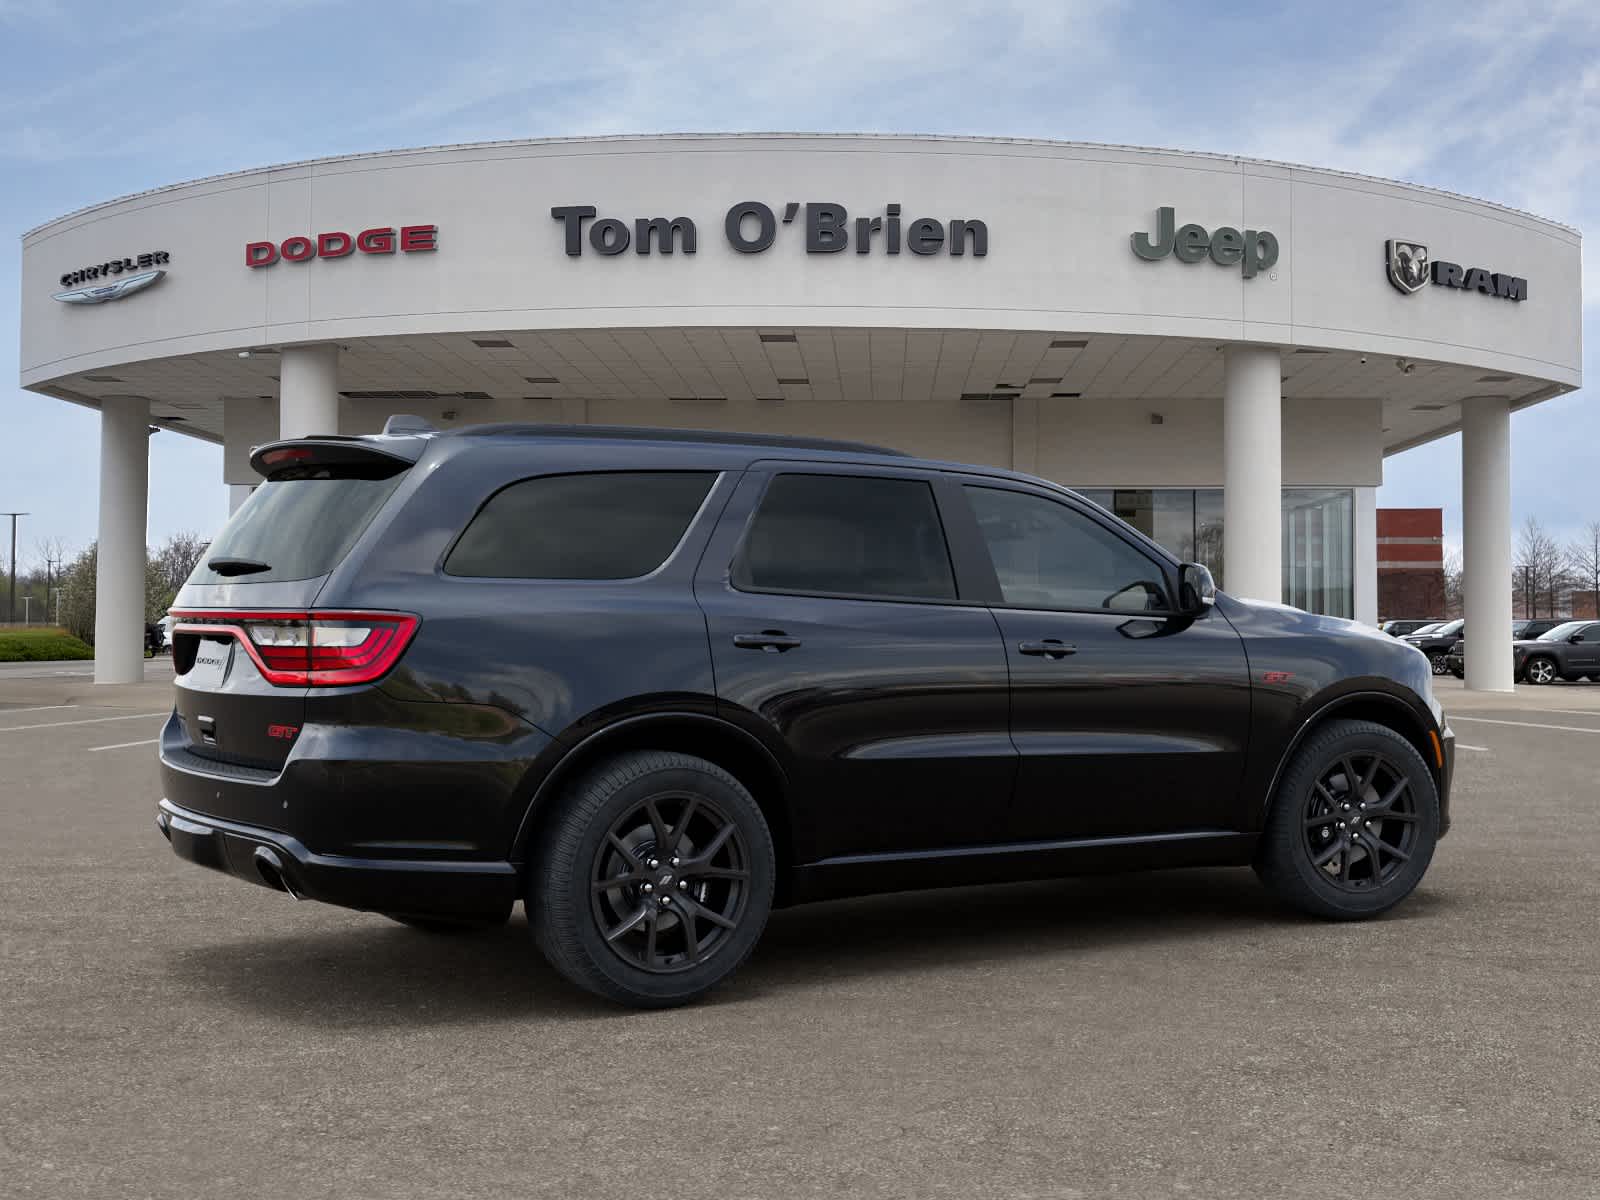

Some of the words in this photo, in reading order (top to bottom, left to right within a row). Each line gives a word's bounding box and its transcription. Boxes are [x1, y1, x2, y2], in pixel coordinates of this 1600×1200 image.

[245, 225, 437, 269] DODGE
[551, 205, 697, 256] Tom
[725, 200, 989, 256] O'Brien
[1130, 207, 1279, 279] Jeep
[60, 251, 169, 287] CHRYSLER
[1430, 261, 1528, 302] RAM
[267, 724, 299, 739] GT
